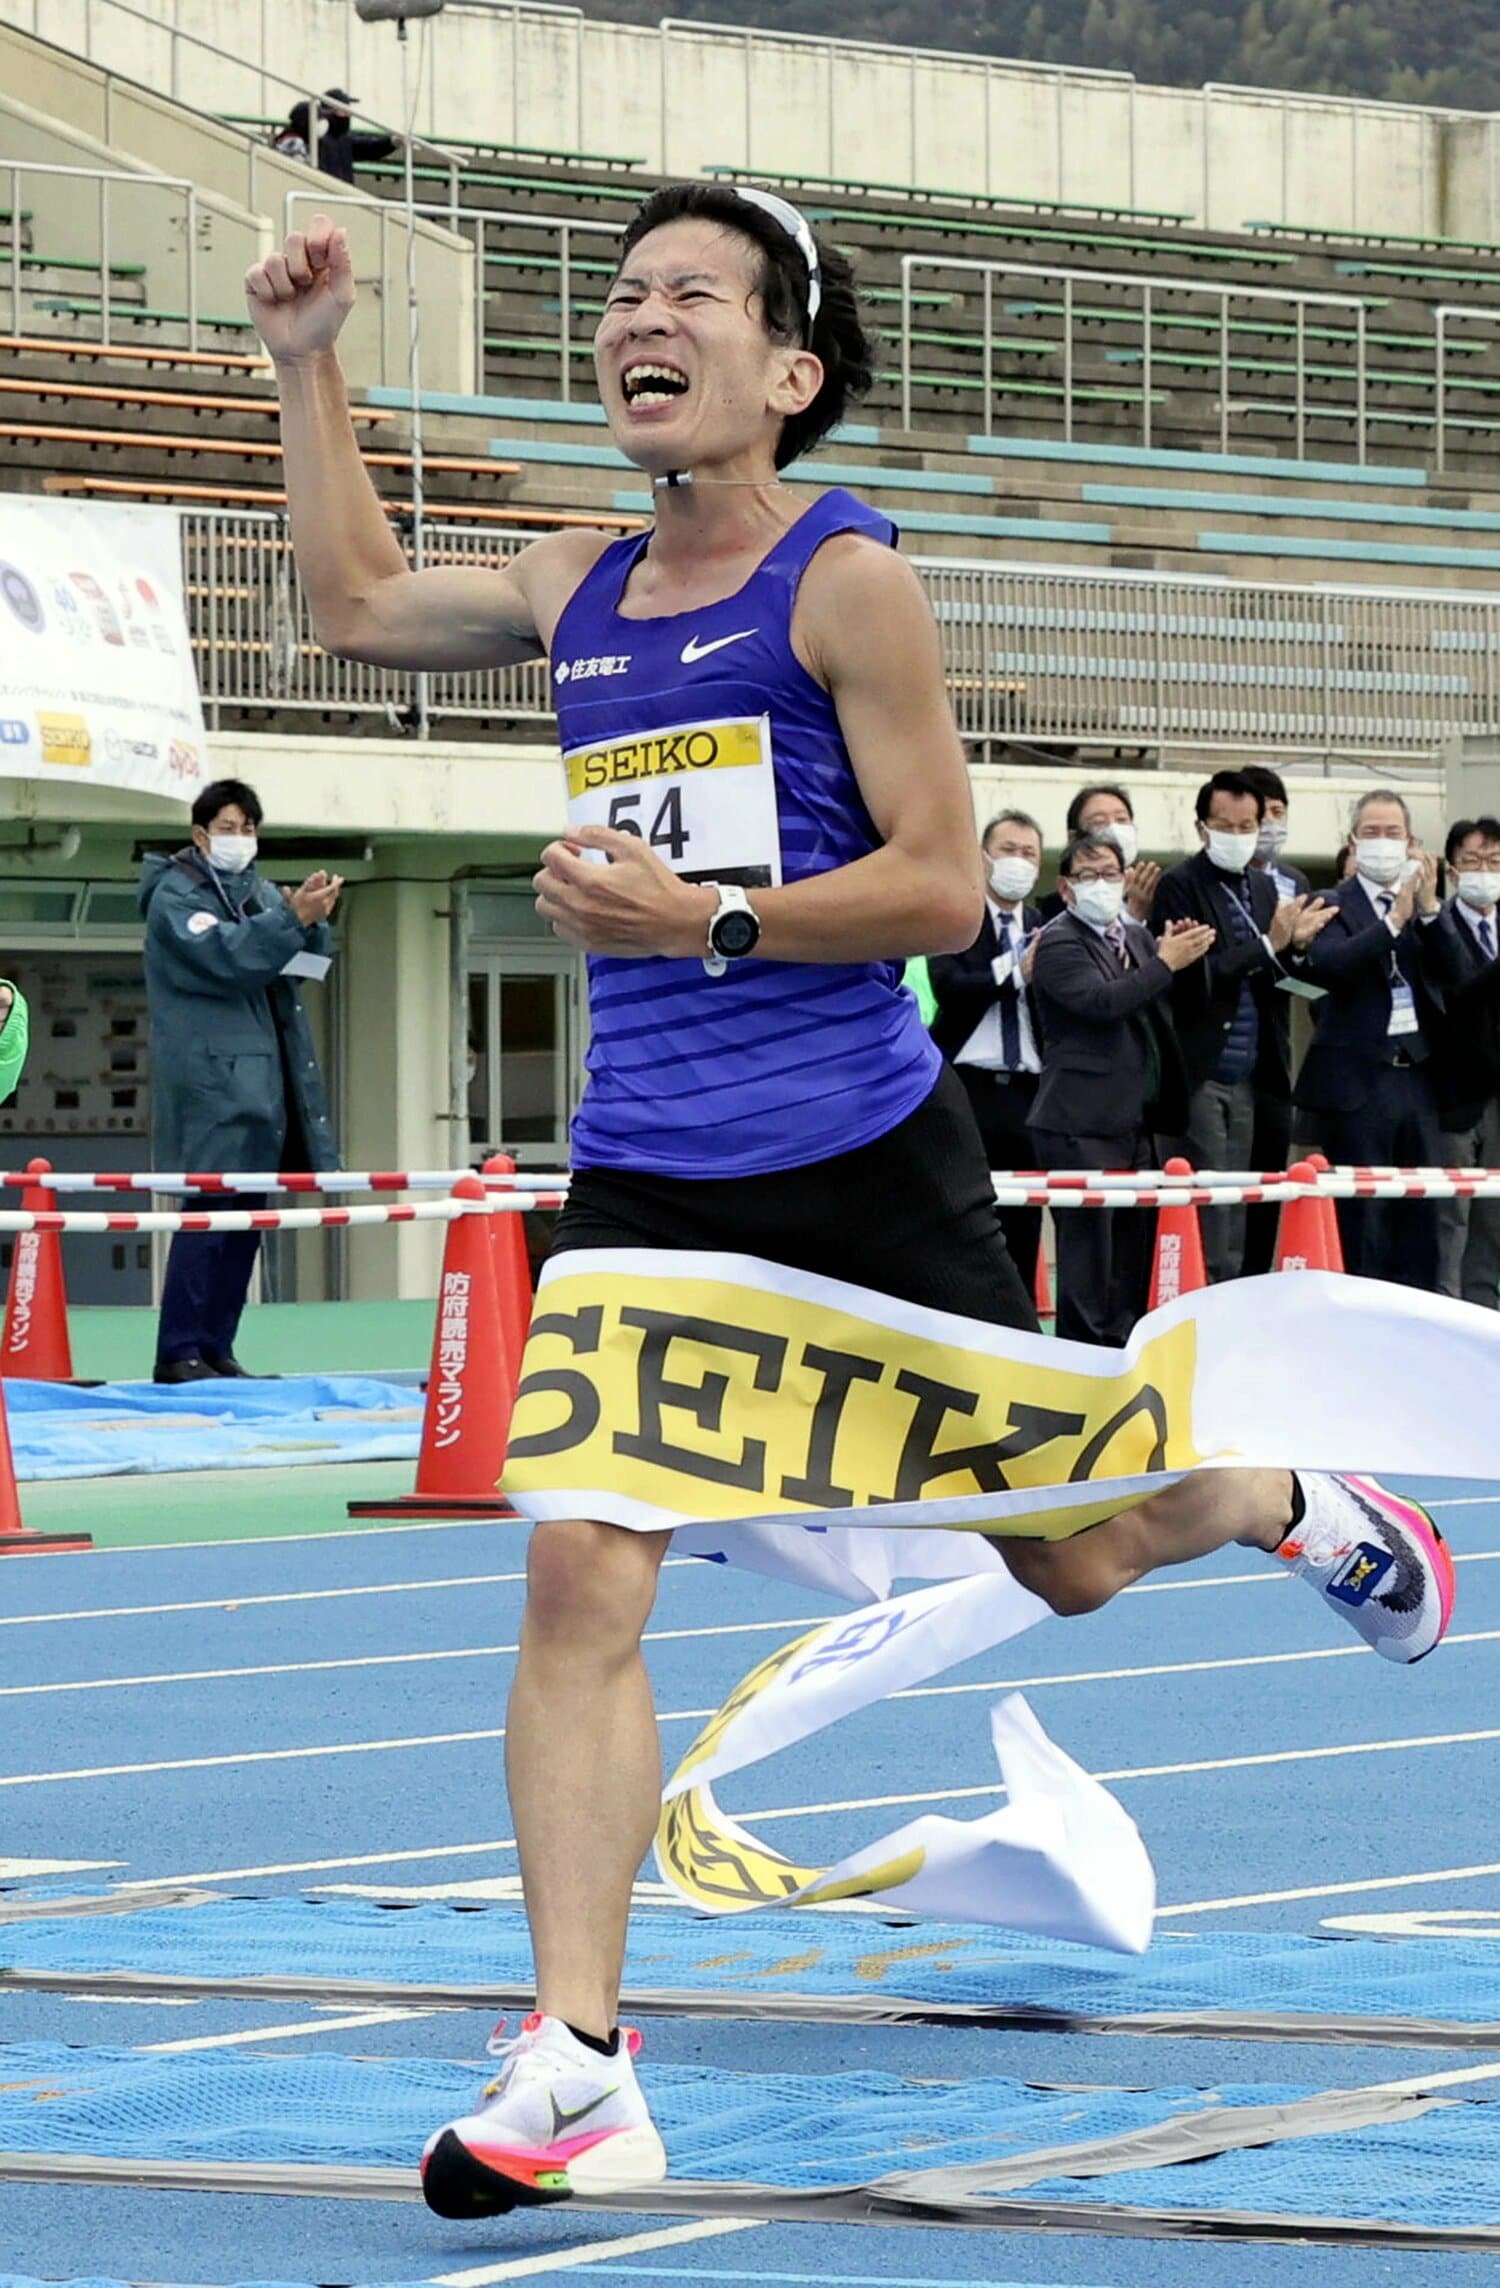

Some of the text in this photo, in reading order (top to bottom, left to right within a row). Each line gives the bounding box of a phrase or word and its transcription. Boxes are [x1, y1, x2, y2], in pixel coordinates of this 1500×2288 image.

[570, 656, 632, 681] 住友電工
[584, 731, 719, 788] SEIKO
[605, 786, 690, 864] 54
[434, 1271, 472, 1449] 防府読売マラソン
[506, 1304, 1169, 1509] SEIKO
